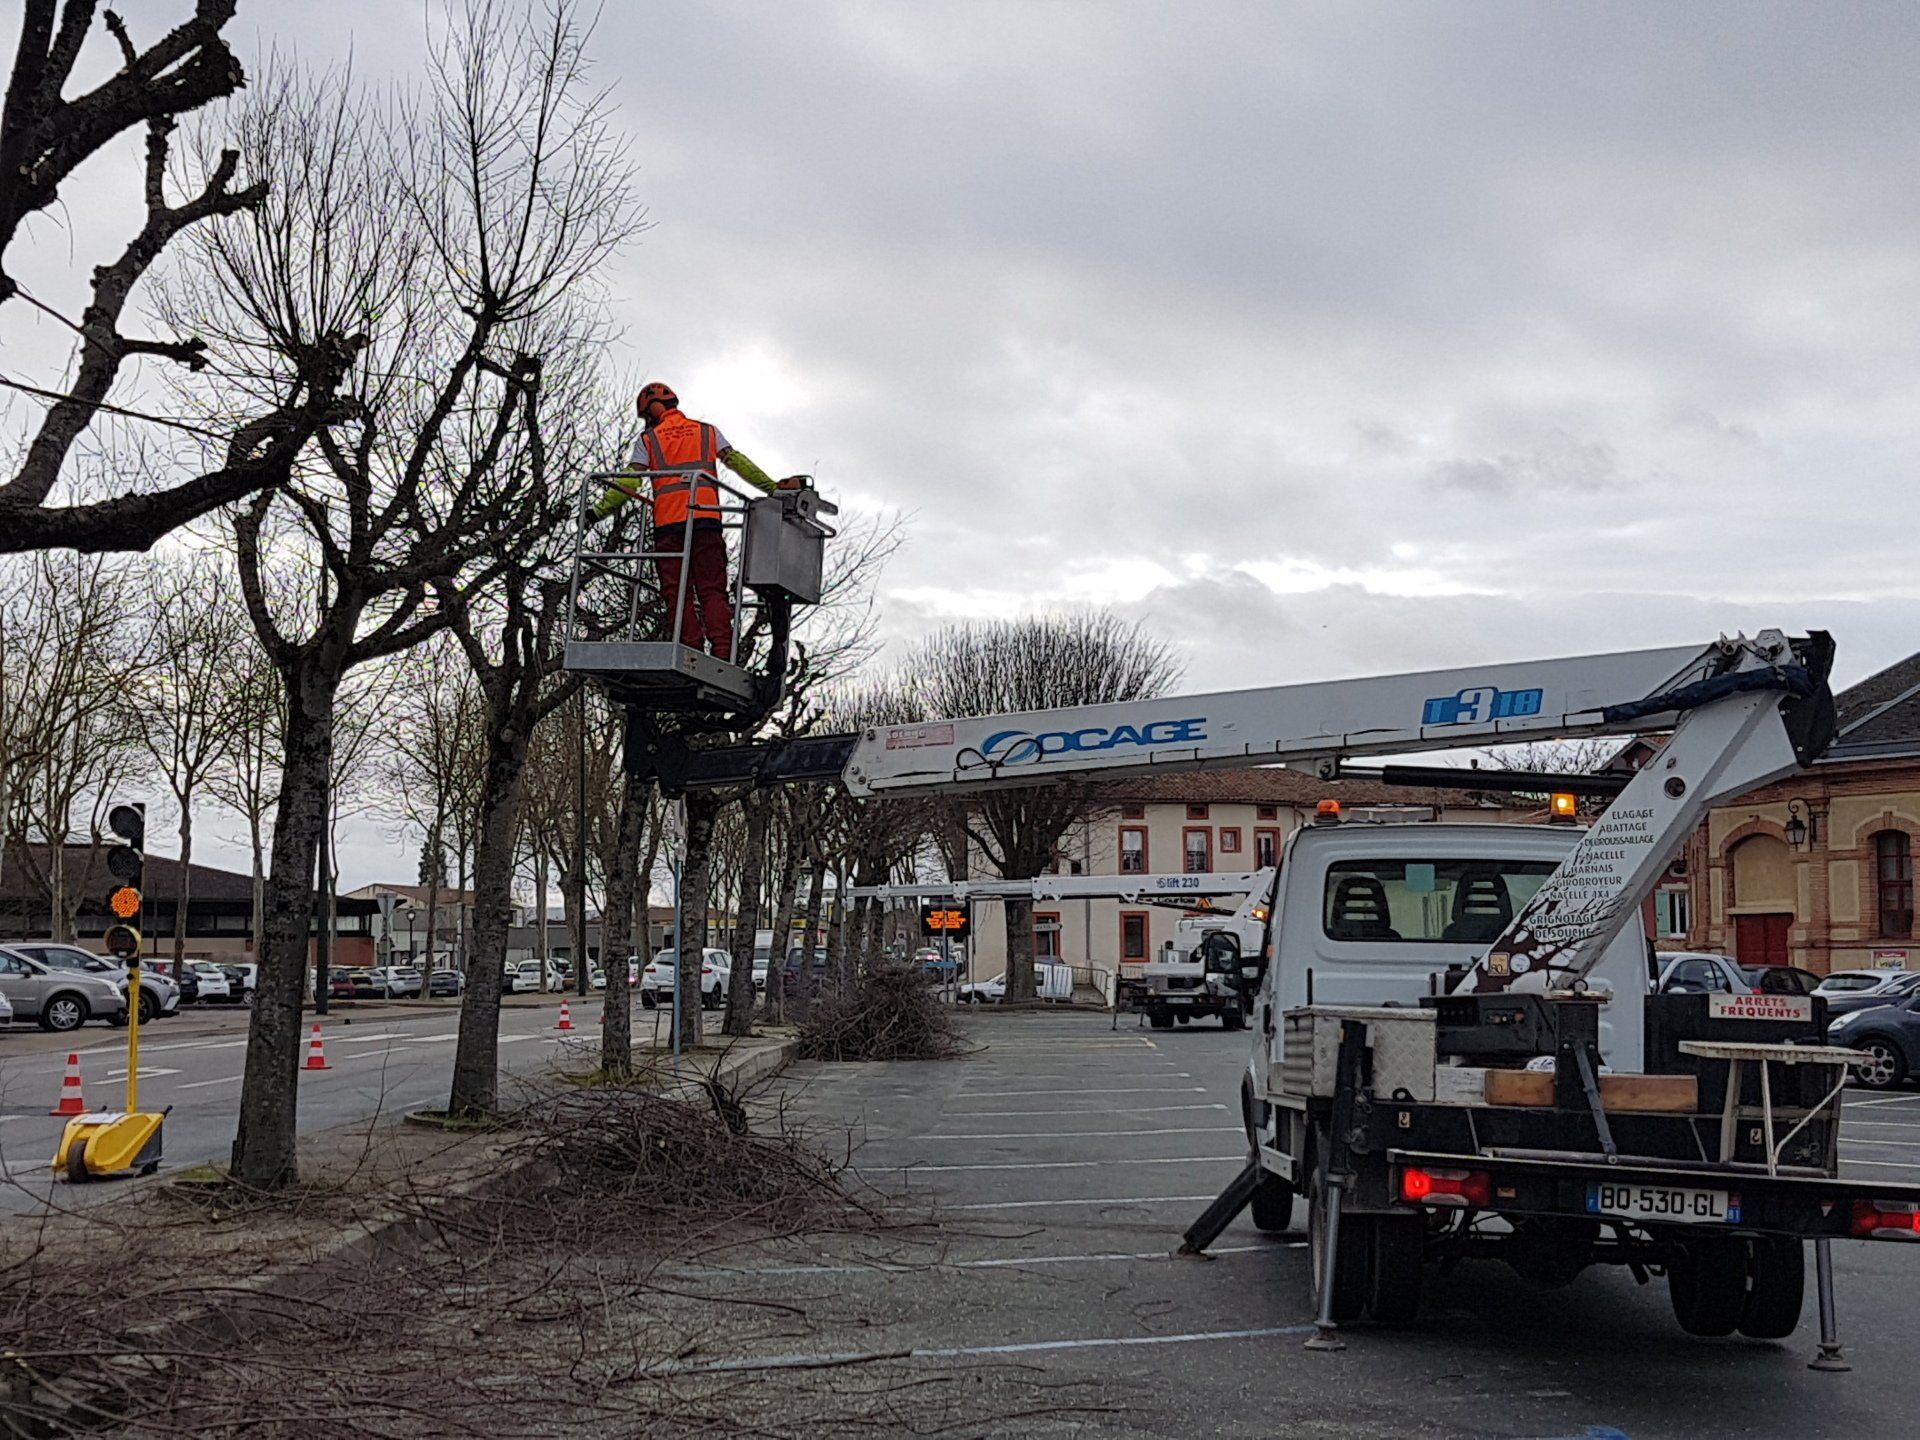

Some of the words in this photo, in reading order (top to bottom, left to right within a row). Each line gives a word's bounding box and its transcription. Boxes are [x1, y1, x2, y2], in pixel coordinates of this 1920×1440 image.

[1612, 808, 1654, 820] ELAGAGE
[1600, 822, 1647, 833] ABATTAGE
[1586, 850, 1625, 861] NACELLE
[1571, 863, 1613, 875] HARNAIS
[1182, 877, 1199, 888] 230
[1556, 876, 1622, 888] GIROBROYEUR
[1550, 890, 1588, 900] NACELLE
[1529, 913, 1597, 925] GRIGNOTAGE
[1535, 930, 1547, 939] DE
[1551, 928, 1591, 937] SOUCHE
[1735, 996, 1787, 1007] ARRETS
[1720, 1006, 1801, 1018] FREQUENTS
[1601, 1186, 1723, 1218] BQ-530-GL
